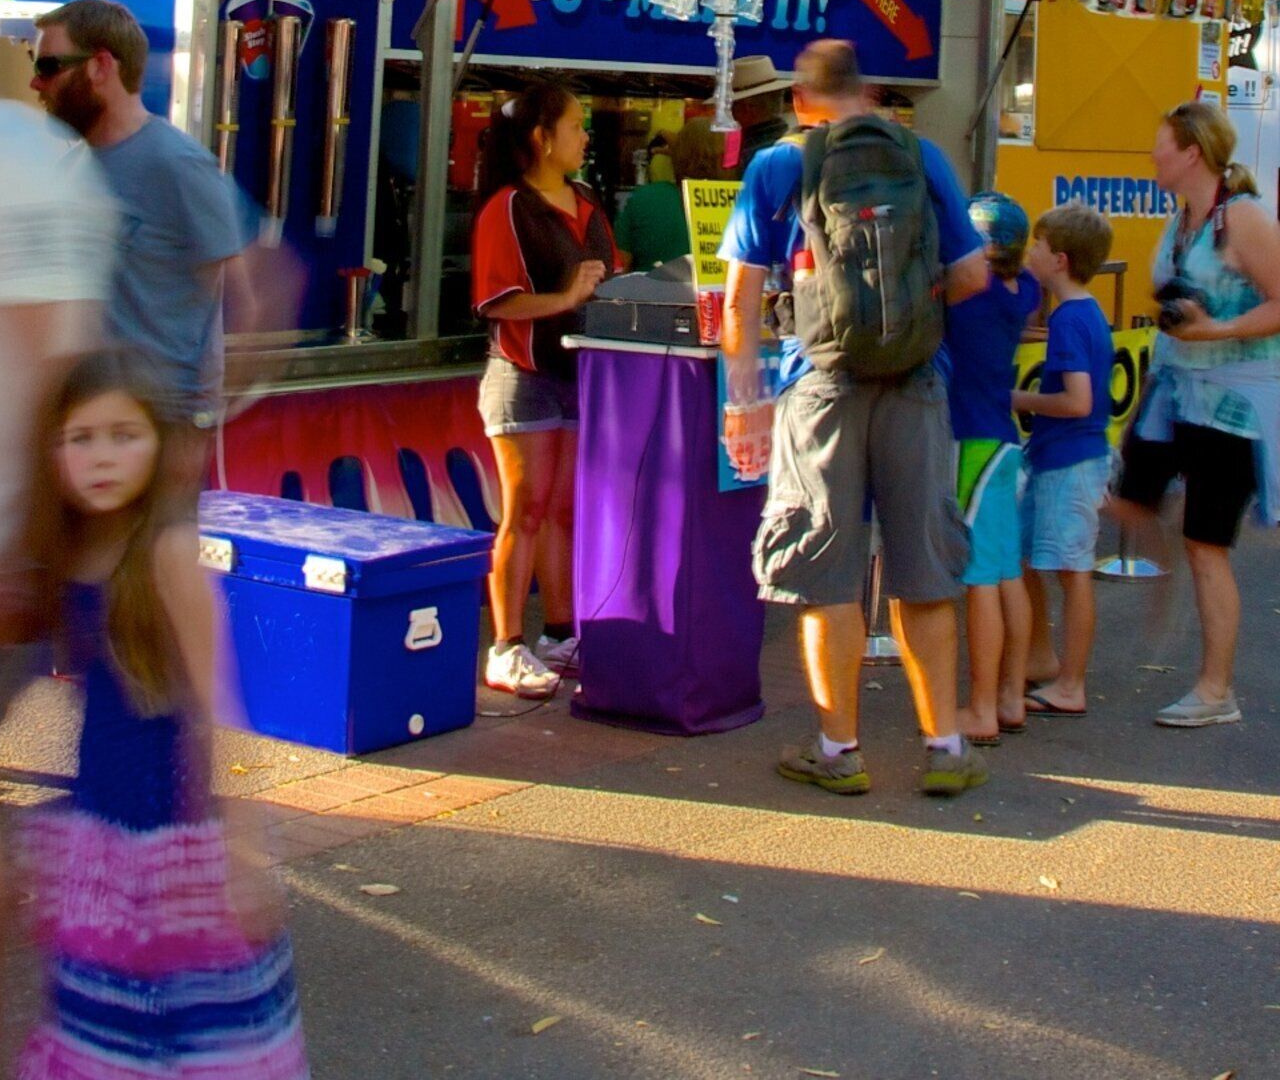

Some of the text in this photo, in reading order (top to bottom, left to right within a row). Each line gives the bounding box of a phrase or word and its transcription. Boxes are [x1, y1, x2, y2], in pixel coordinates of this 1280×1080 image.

[1228, 84, 1238, 97] e
[694, 187, 739, 208] SLUSH
[1055, 175, 1179, 217] POFFERTJES
